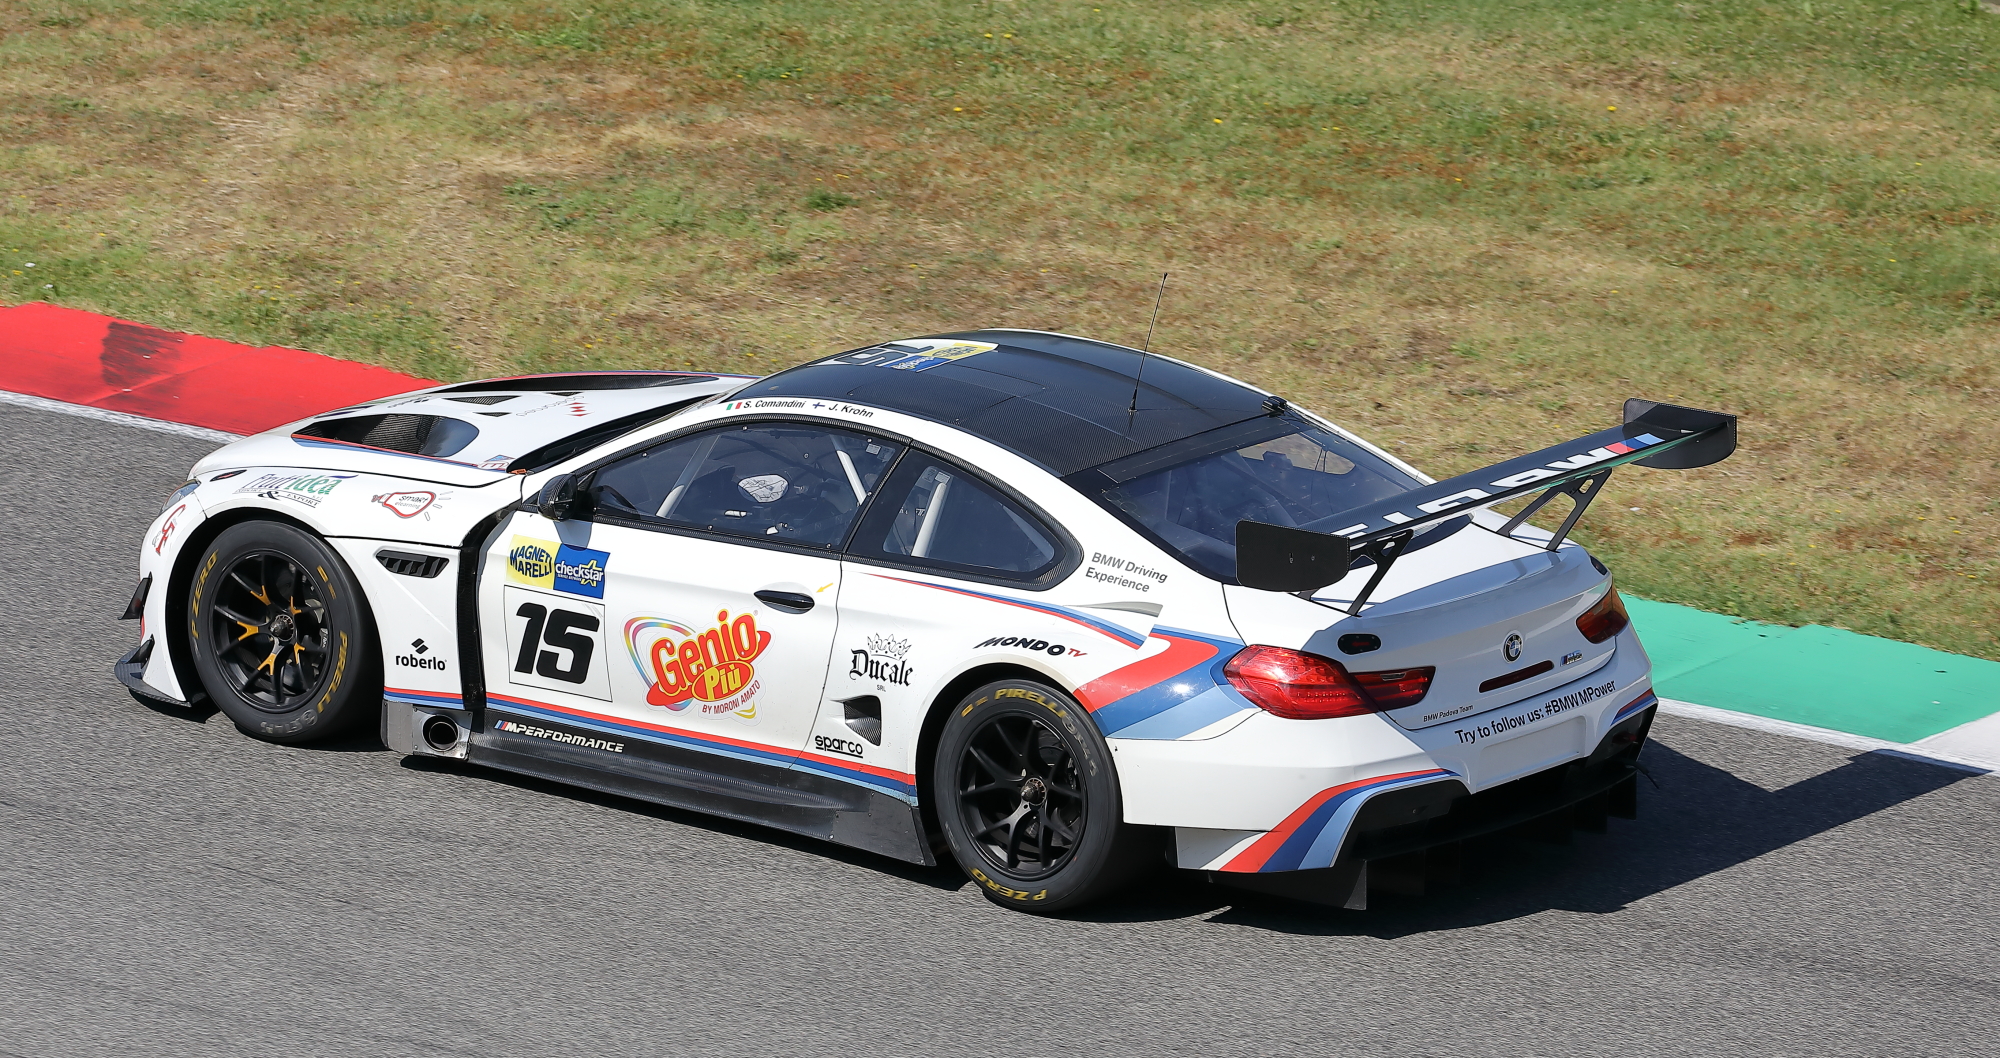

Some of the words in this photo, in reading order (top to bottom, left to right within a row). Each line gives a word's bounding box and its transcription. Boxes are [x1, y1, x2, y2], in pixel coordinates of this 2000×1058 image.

[743, 400, 752, 409] S.
[754, 400, 807, 409] Comandini
[828, 403, 839, 411] J.
[840, 404, 874, 419] Krohn
[509, 545, 553, 565] MAGNETI
[509, 557, 553, 578] MARELLI
[1091, 552, 1126, 570] BMW
[1125, 561, 1168, 584] Driving
[192, 549, 219, 618] ZERO
[555, 560, 604, 582] checkstar
[1085, 566, 1150, 593] Experience
[191, 621, 199, 640] P
[514, 602, 601, 685] 15
[651, 608, 759, 697] Genio
[972, 636, 1066, 656] MONDO
[1067, 648, 1088, 658] TV
[318, 630, 348, 713] PIRELLI
[395, 653, 447, 671] roberlo
[849, 648, 914, 687] Ducale
[703, 664, 742, 701] Più
[701, 704, 713, 715] BY
[713, 699, 740, 715] MORONI
[740, 680, 761, 707] AMATO
[993, 688, 1066, 719] PIRELLI
[1423, 714, 1439, 723] BMW
[1438, 707, 1460, 719] Padova
[1459, 704, 1474, 714] Team
[1454, 729, 1476, 745] Try
[1477, 723, 1491, 739] to
[1491, 715, 1526, 735] follow
[1527, 707, 1545, 724] us:
[815, 734, 864, 758] sparco
[968, 865, 1030, 901] ZERO
[1032, 889, 1048, 901] P
